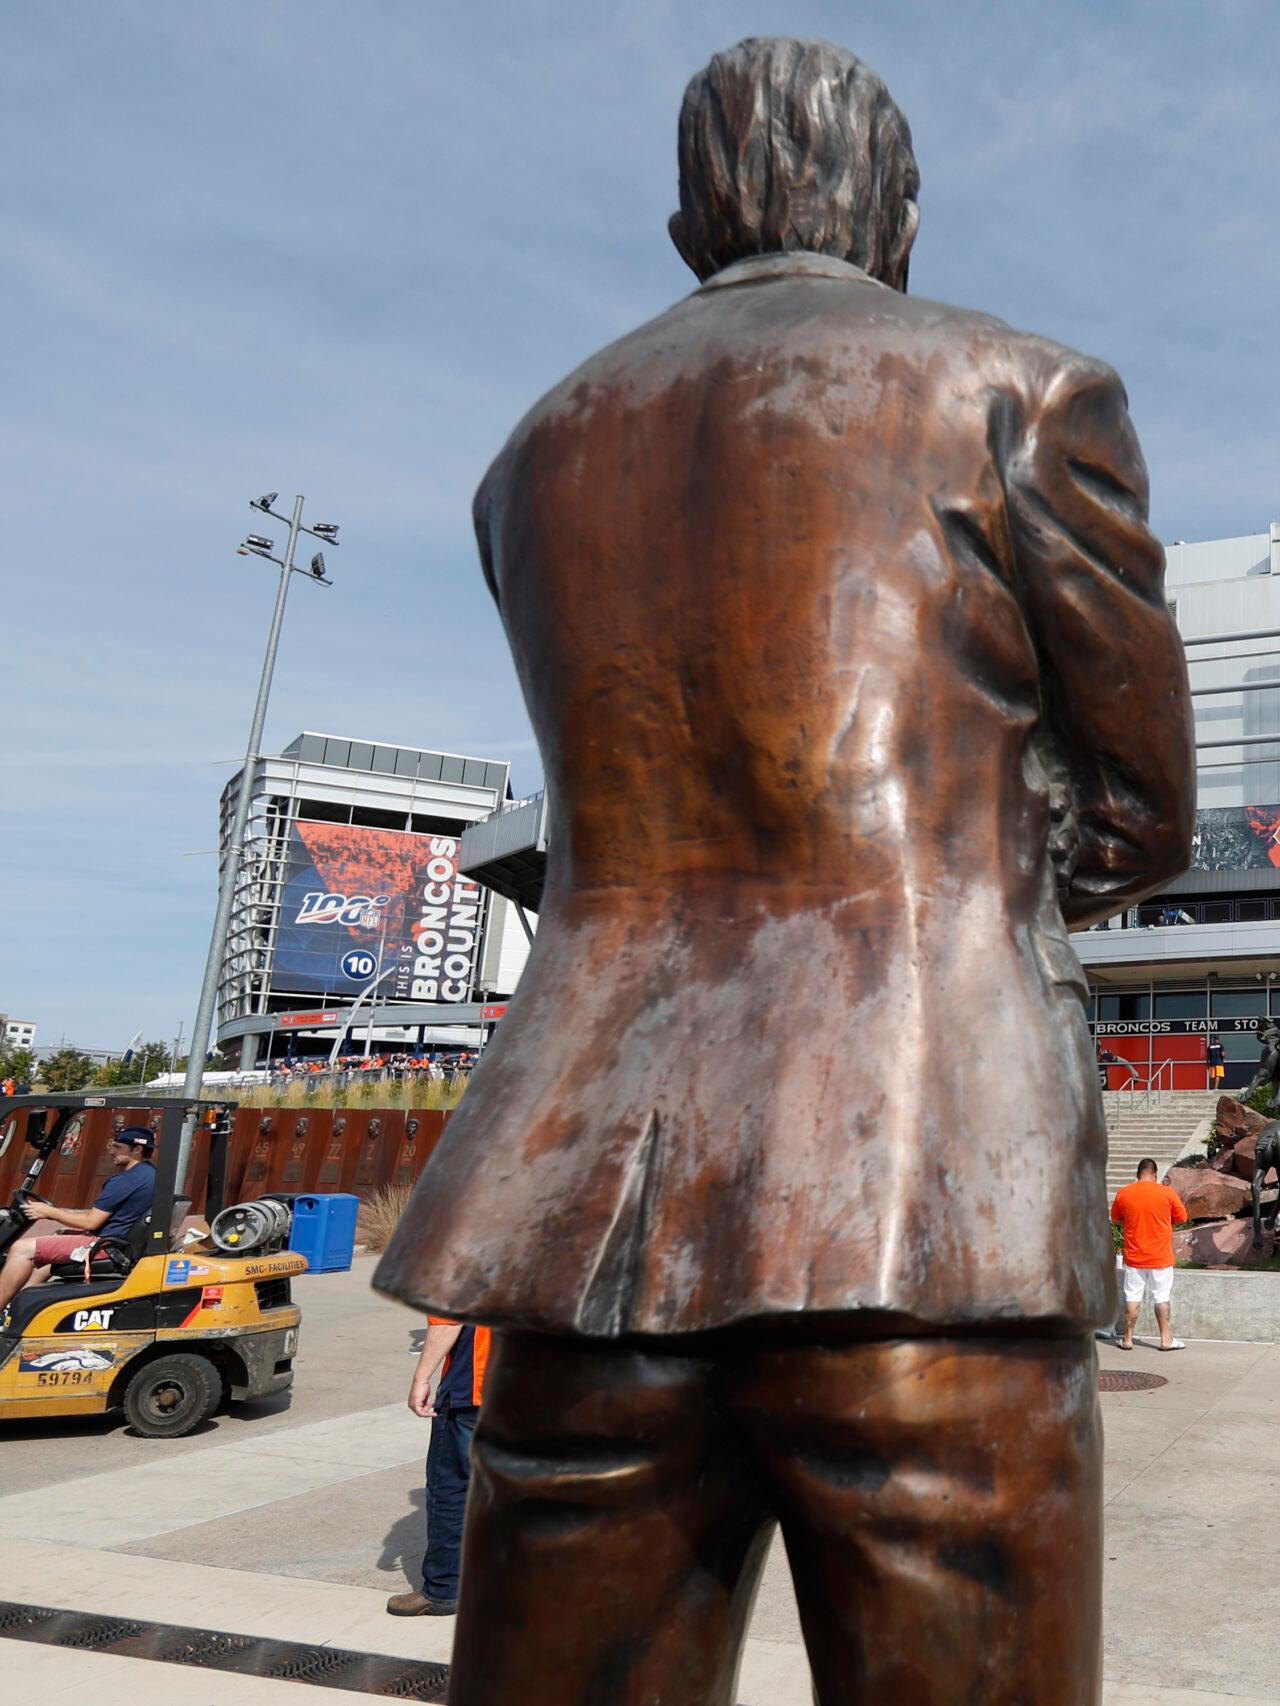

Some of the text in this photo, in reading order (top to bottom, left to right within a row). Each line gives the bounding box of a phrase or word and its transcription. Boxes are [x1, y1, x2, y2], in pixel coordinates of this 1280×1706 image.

[411, 837, 457, 1001] BRONCOS
[441, 873, 479, 1002] COUNT
[347, 958, 373, 974] 10
[396, 945, 413, 998] THIS IS
[1097, 1019, 1265, 1034] BRONCOS TEAM STO
[268, 1260, 304, 1273] FACILITIES
[74, 1310, 114, 1331] CAT
[38, 1372, 94, 1386] 59794
